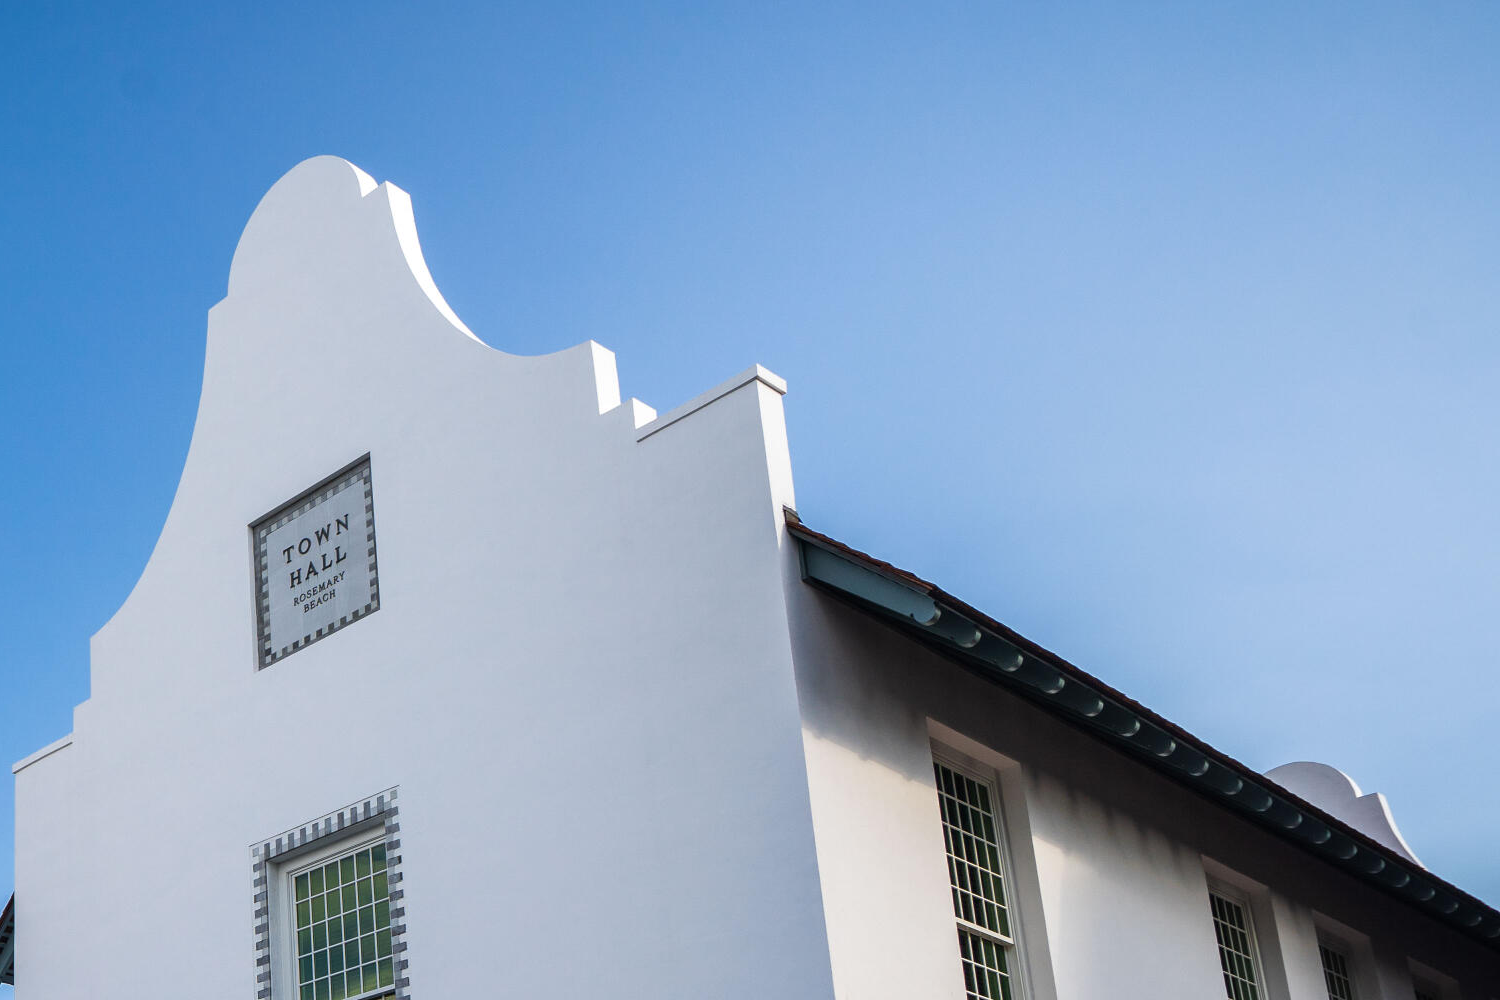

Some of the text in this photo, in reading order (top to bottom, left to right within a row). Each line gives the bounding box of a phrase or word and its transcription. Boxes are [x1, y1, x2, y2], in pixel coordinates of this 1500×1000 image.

[282, 513, 349, 564] TOWN
[289, 545, 347, 589] HALL
[293, 570, 346, 607] ROSEMARY
[303, 588, 336, 614] BEACH
